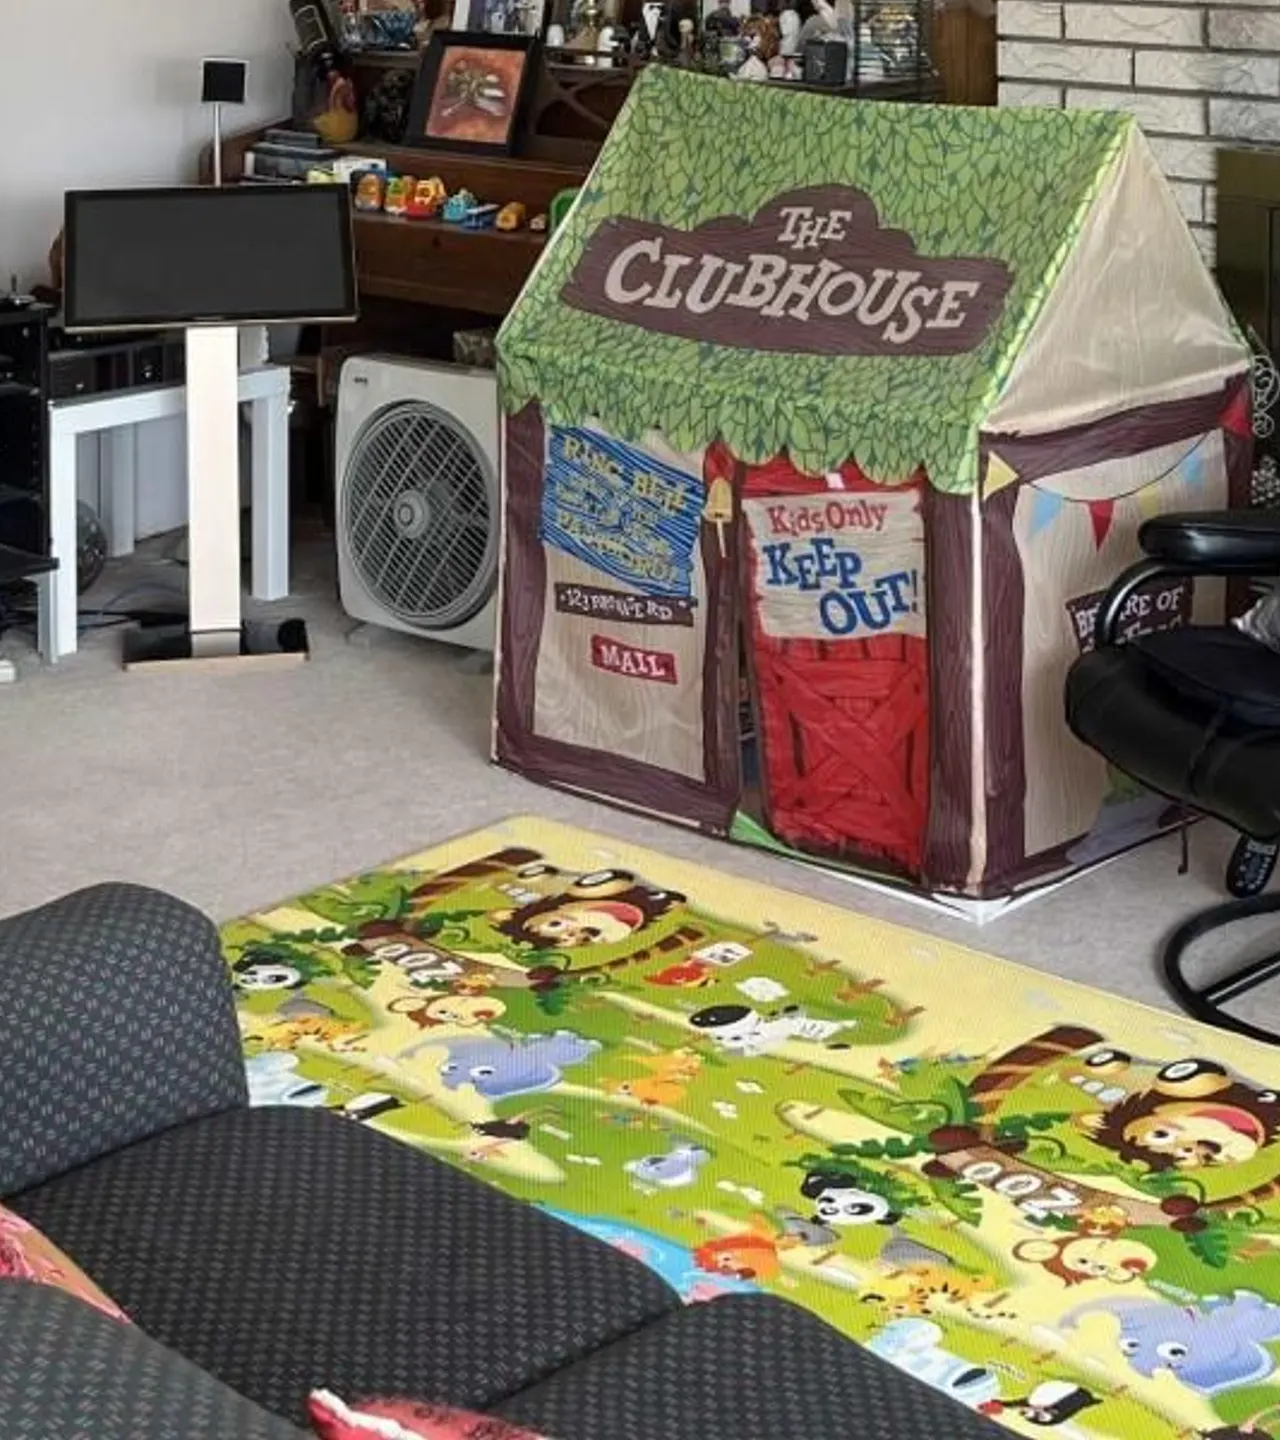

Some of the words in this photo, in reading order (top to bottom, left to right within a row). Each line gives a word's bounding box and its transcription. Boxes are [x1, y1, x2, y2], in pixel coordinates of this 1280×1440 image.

[775, 205, 853, 250] THE
[602, 236, 978, 346] CLUBHOUSE
[767, 504, 826, 538] Kids
[825, 499, 888, 532] Only
[762, 537, 862, 591] KEEP
[820, 568, 919, 635] OUT!
[1074, 593, 1152, 638] BERE
[1156, 586, 1184, 611] OF
[599, 644, 666, 677] MAIL
[373, 942, 465, 978] ZOO
[962, 1162, 1085, 1220] ZOO
